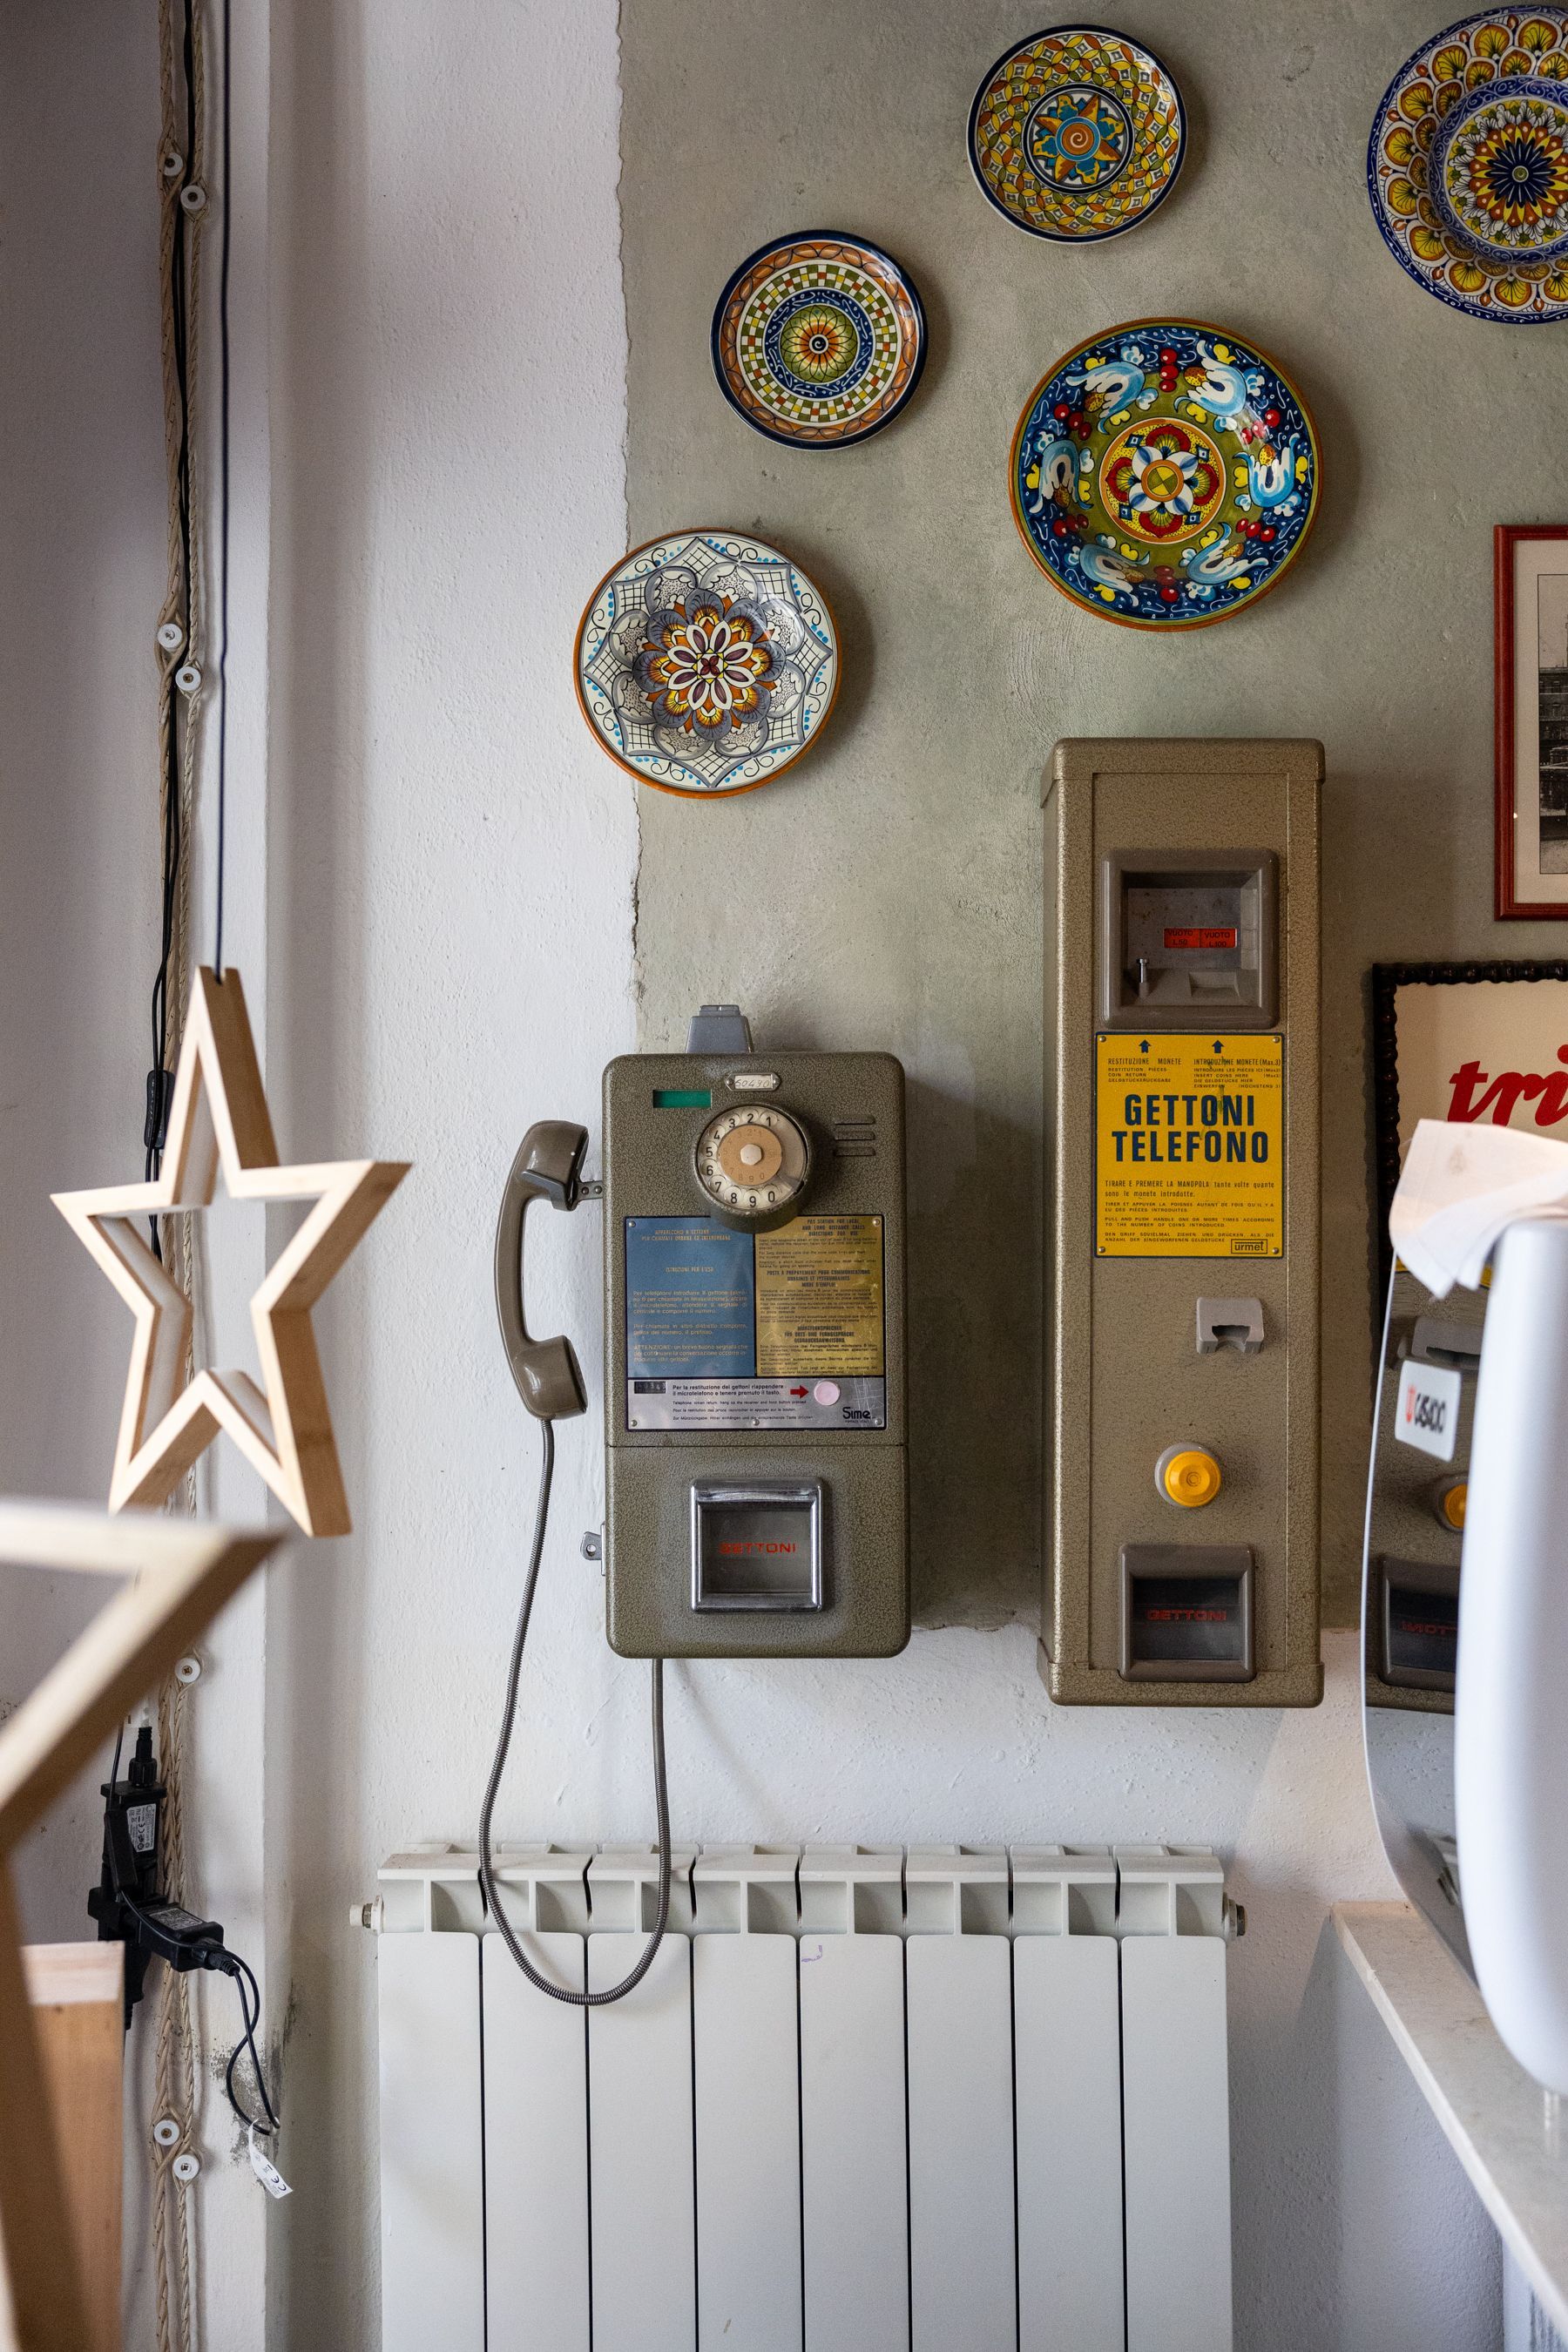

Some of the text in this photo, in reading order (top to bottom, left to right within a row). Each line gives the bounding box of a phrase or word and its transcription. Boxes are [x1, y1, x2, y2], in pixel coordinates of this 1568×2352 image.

[1125, 1094, 1254, 1126] GETTONI
[729, 1119, 735, 1128] 3
[747, 1113, 754, 1124] 2
[767, 1117, 771, 1126] 1
[714, 1131, 720, 1139] 4
[706, 1147, 713, 1157] 5
[1112, 1131, 1268, 1163] TELEFONO
[707, 1166, 713, 1176] 6
[715, 1182, 721, 1193] 7
[731, 1193, 737, 1204] 8
[749, 1196, 756, 1206] 9
[768, 1191, 774, 1202] 0
[1234, 1241, 1264, 1251] urmet
[842, 1407, 870, 1419] Sime
